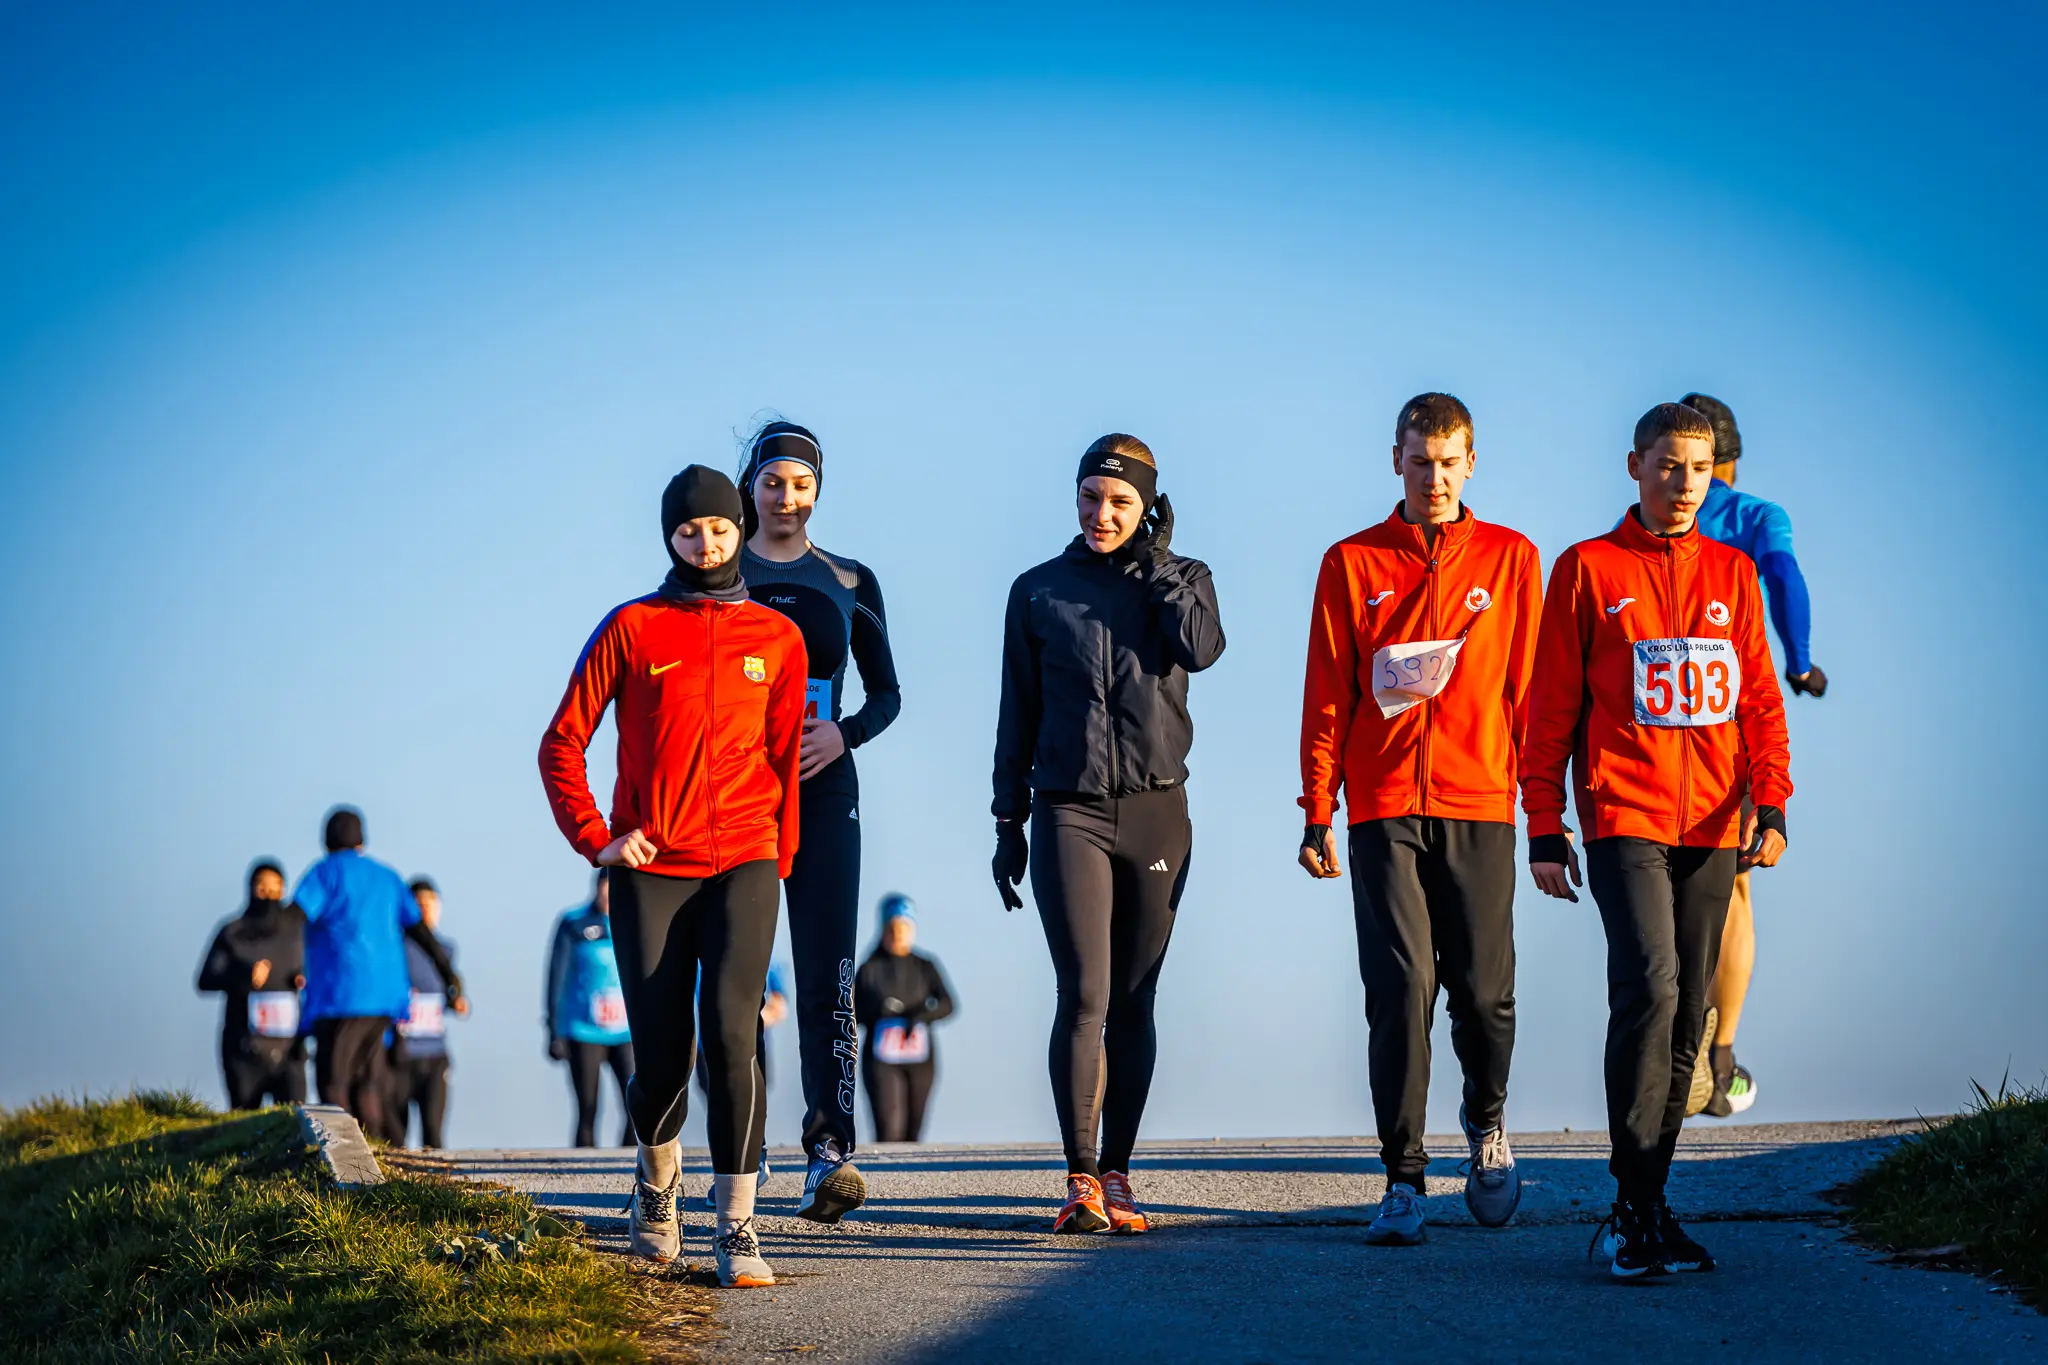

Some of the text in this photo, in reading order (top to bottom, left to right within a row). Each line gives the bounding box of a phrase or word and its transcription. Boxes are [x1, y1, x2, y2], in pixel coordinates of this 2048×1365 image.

[1647, 643, 1725, 653] KROS LIGA PRELOG
[1383, 656, 1441, 689] 592
[1646, 660, 1730, 717] 593
[833, 958, 859, 1114] adidas
